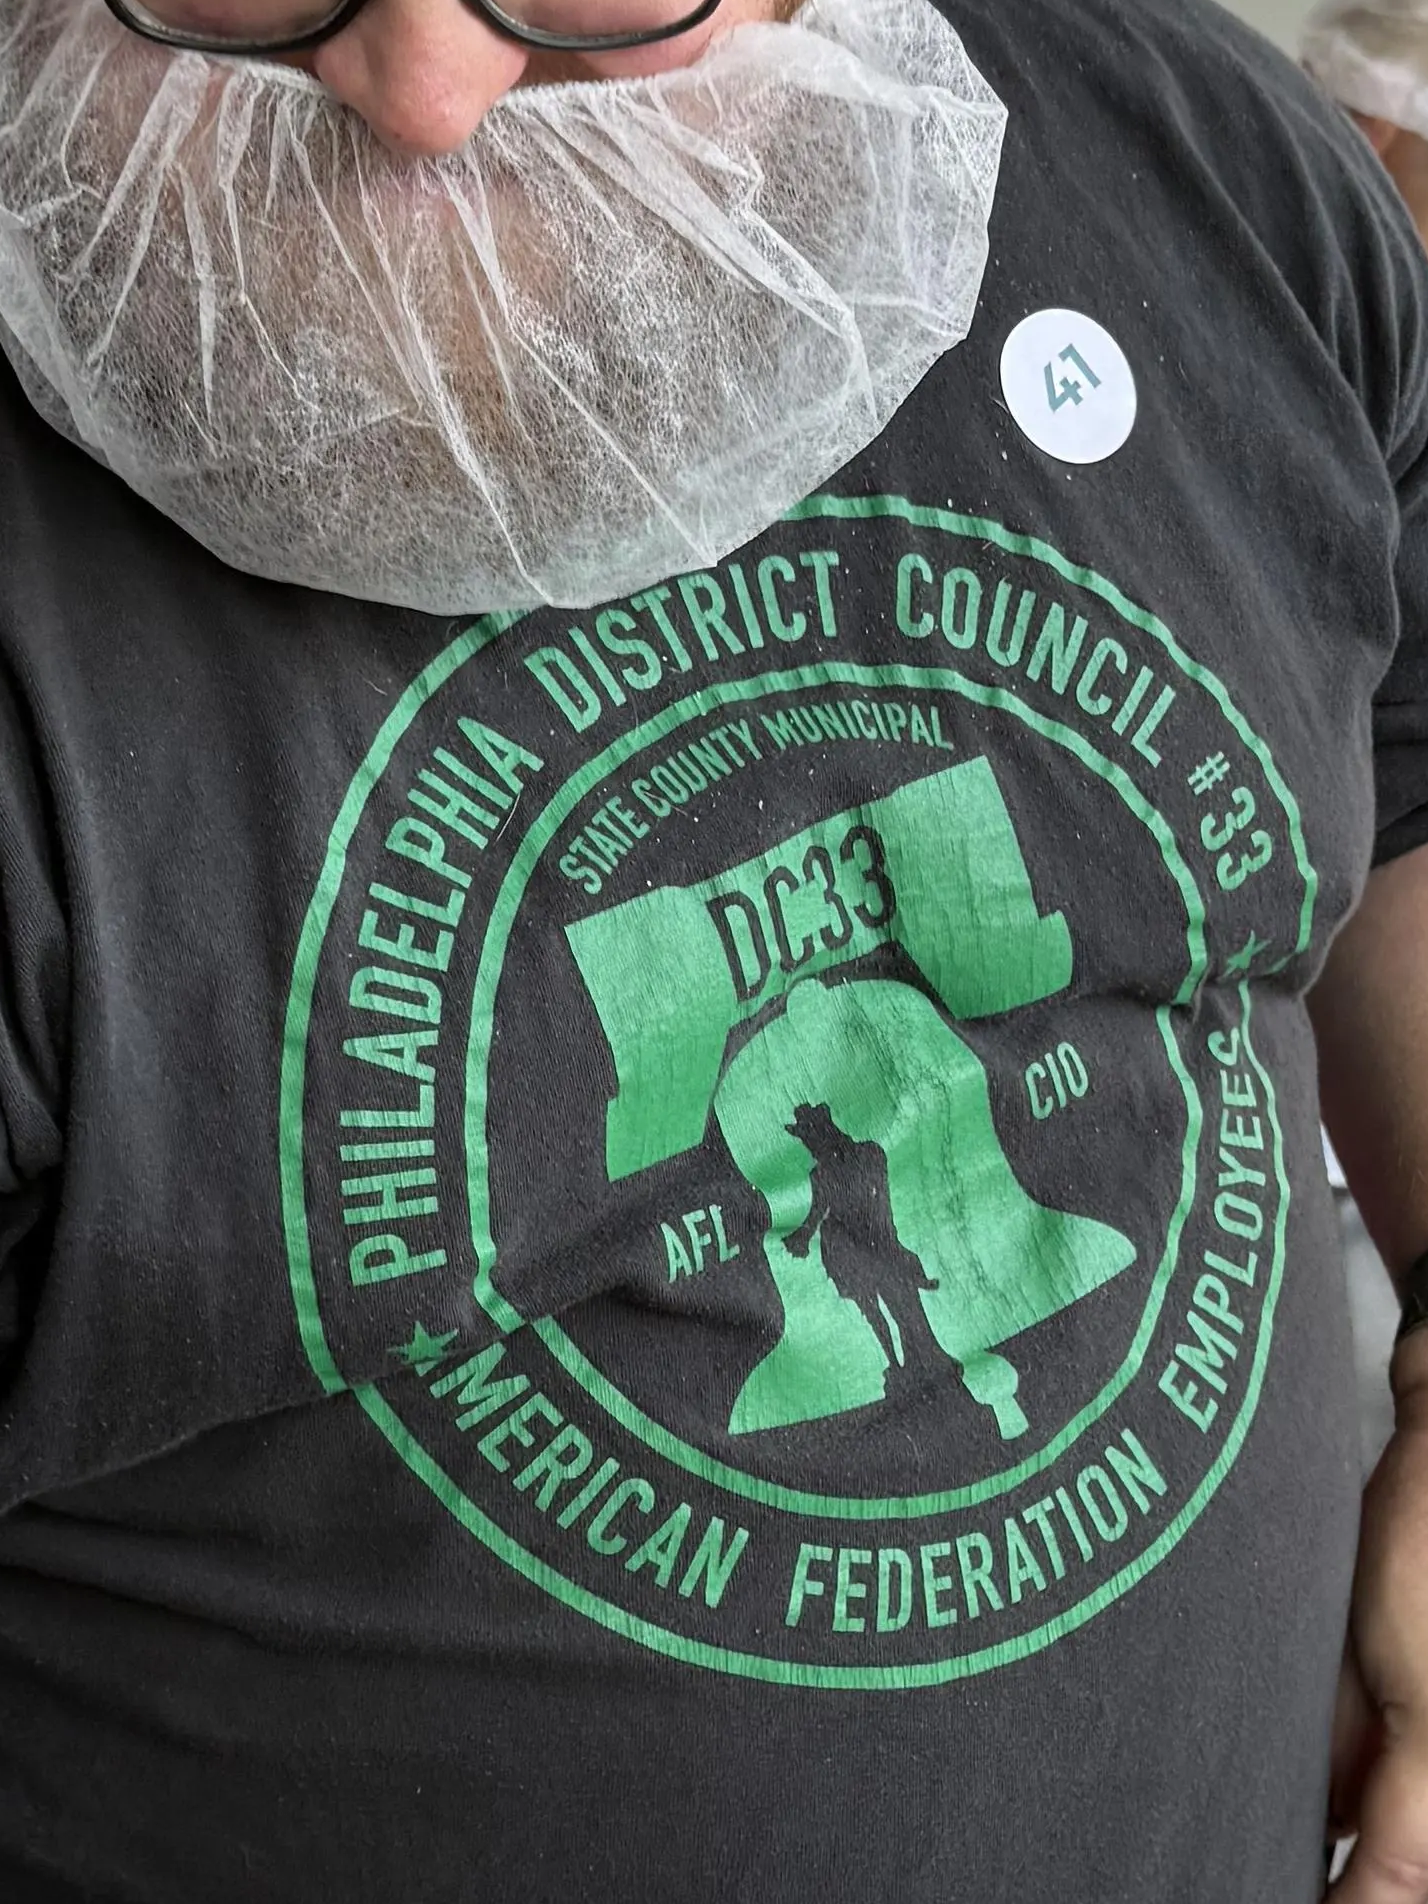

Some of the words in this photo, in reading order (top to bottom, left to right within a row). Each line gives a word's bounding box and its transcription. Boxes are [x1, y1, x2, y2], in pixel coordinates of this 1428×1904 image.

[1044, 343, 1102, 413] 41
[559, 796, 650, 895] STATE
[631, 718, 762, 817] COUNTY
[760, 699, 954, 751] MUNICIPAL
[340, 712, 545, 1287] PHILADELPHIA
[525, 550, 840, 732] DISTRICT
[896, 553, 1180, 769] COUNCIL
[1187, 751, 1273, 892] #33
[705, 825, 897, 1003] DC33
[1021, 1043, 1092, 1122] CIO
[429, 1342, 750, 1609] MERICAN
[784, 1426, 1170, 1634] FEDERATION
[1159, 1028, 1267, 1432] EMPLOYEES
[659, 1203, 742, 1284] AFL
